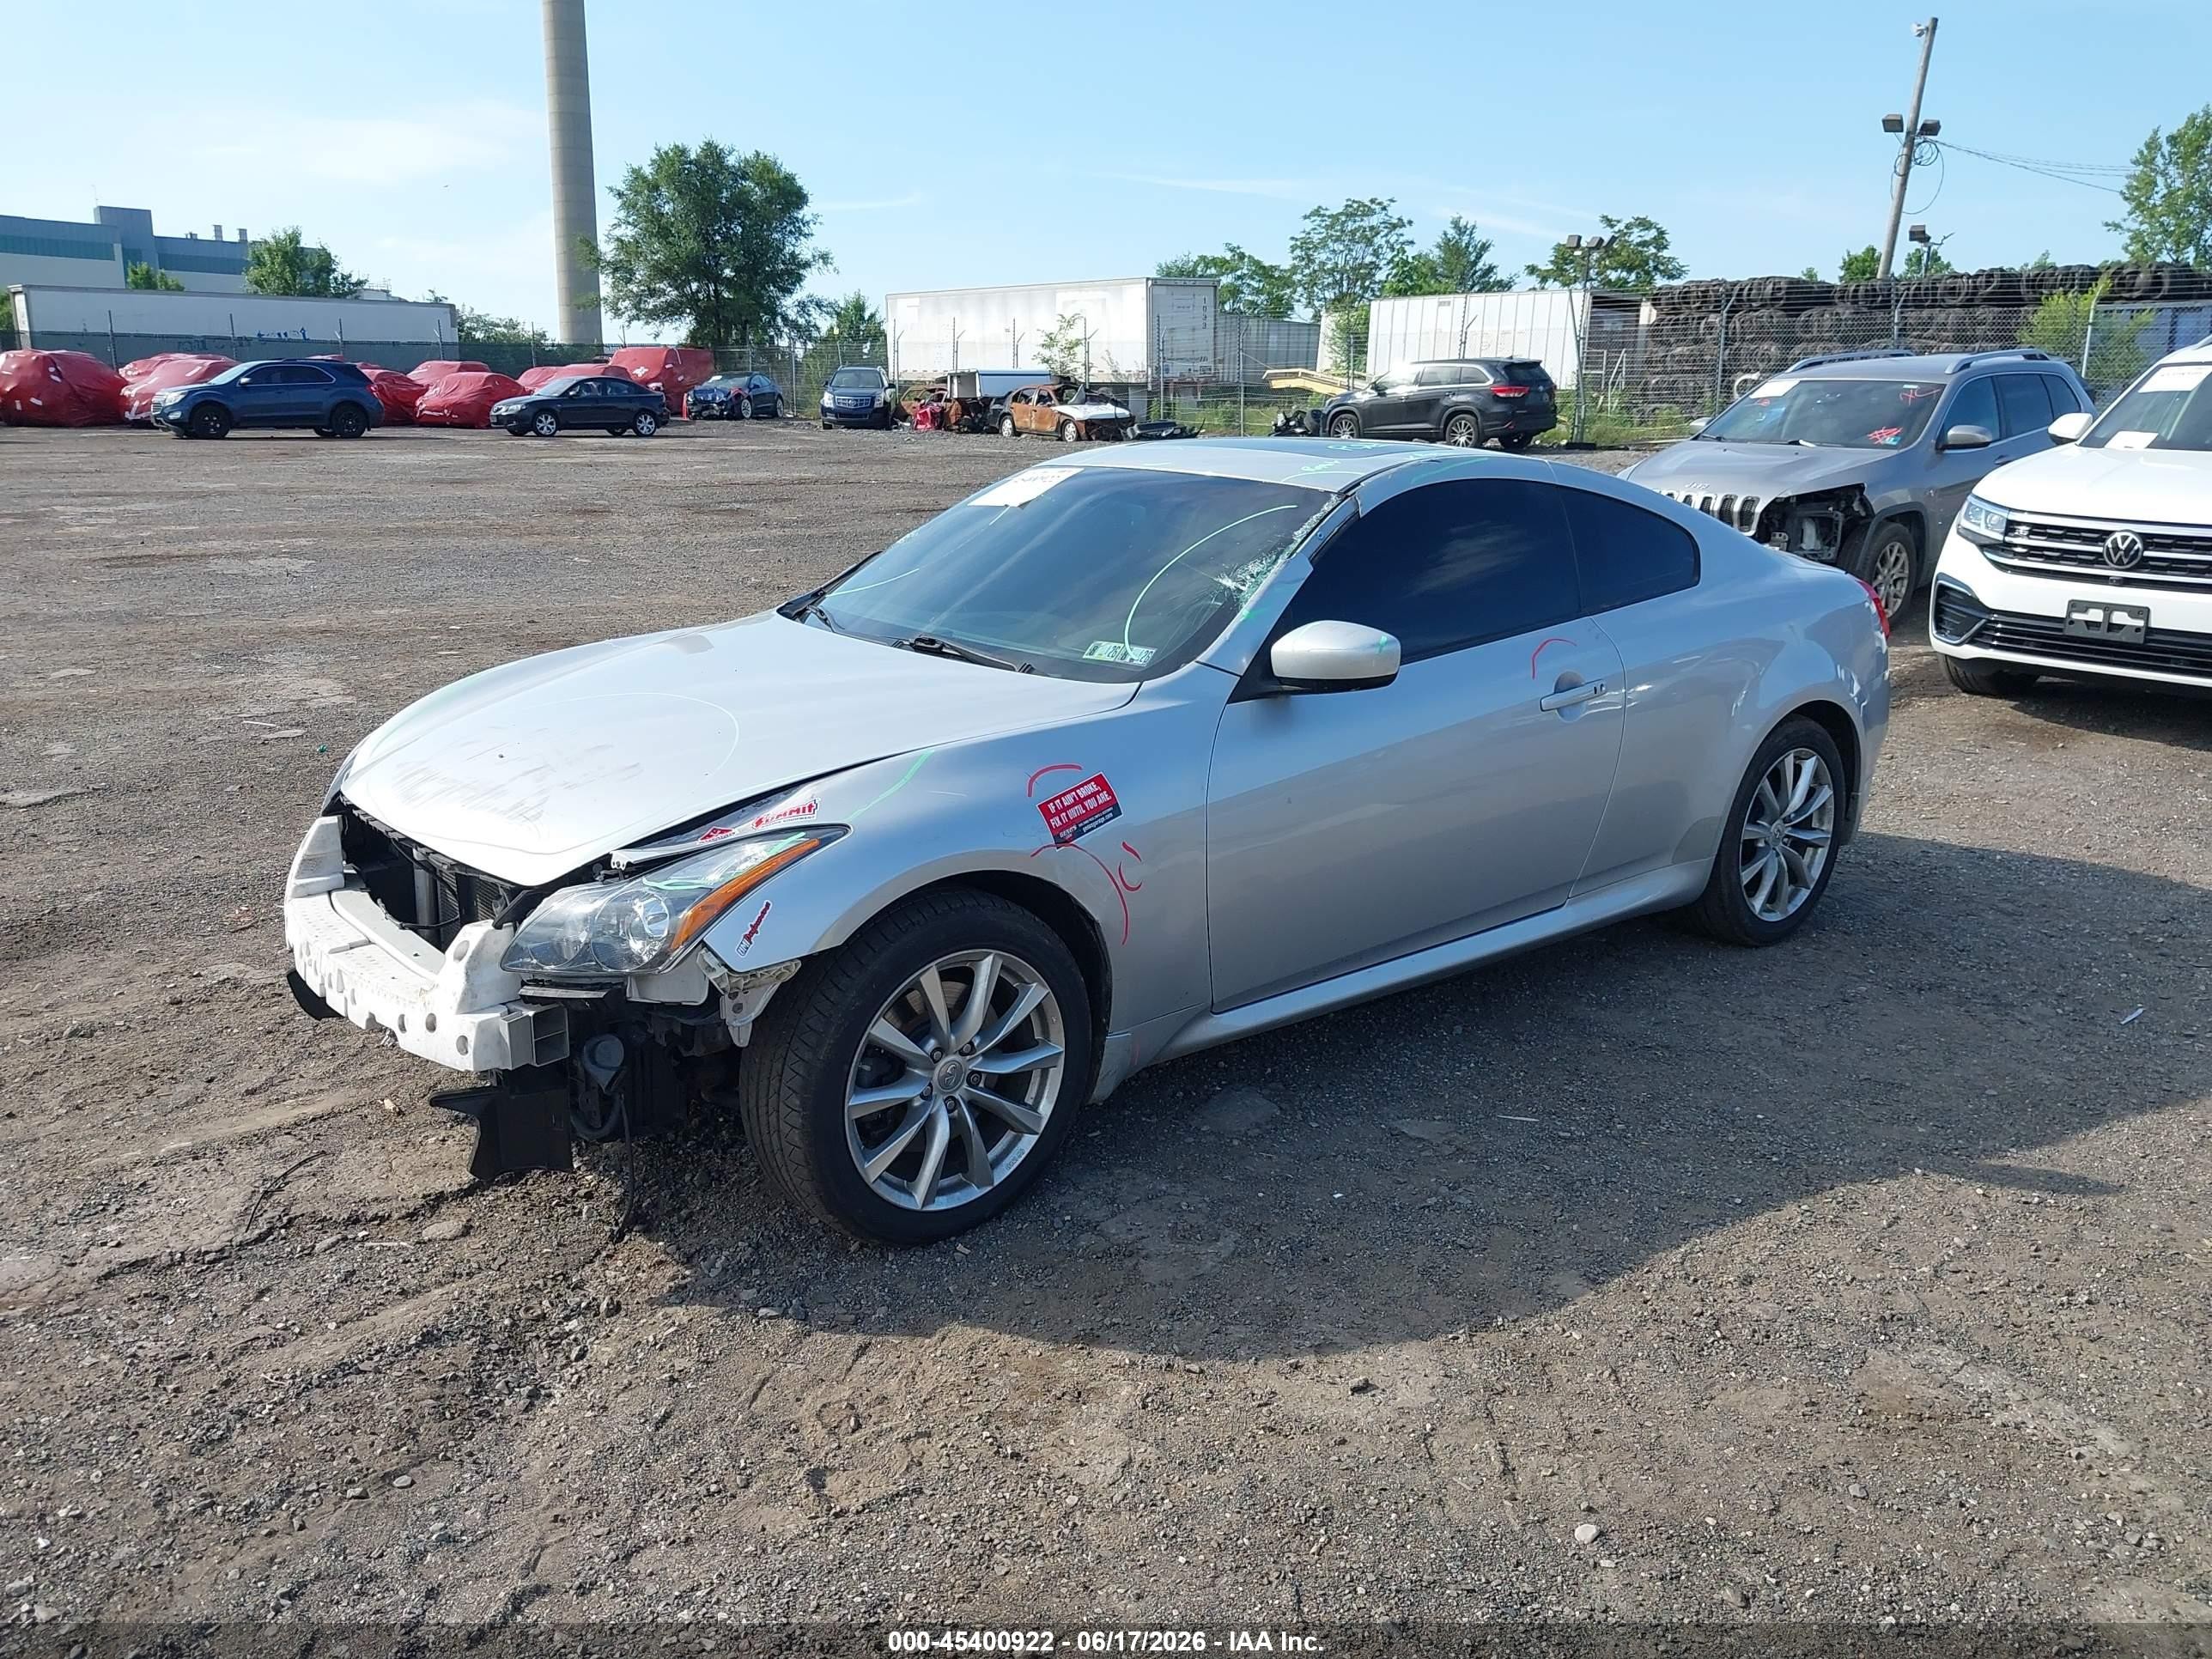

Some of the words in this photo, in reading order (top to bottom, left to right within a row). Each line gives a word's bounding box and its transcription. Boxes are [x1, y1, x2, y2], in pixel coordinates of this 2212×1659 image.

[1048, 802, 1055, 813] IF
[1054, 799, 1063, 810] IT
[1061, 791, 1079, 807] AIN'T
[1076, 781, 1102, 799] BROKE,
[1049, 817, 1062, 830] FIX
[1060, 812, 1069, 823] IT
[1067, 804, 1086, 820] UNTIL
[1084, 797, 1097, 811] YOU
[1097, 791, 1112, 805] ARE.
